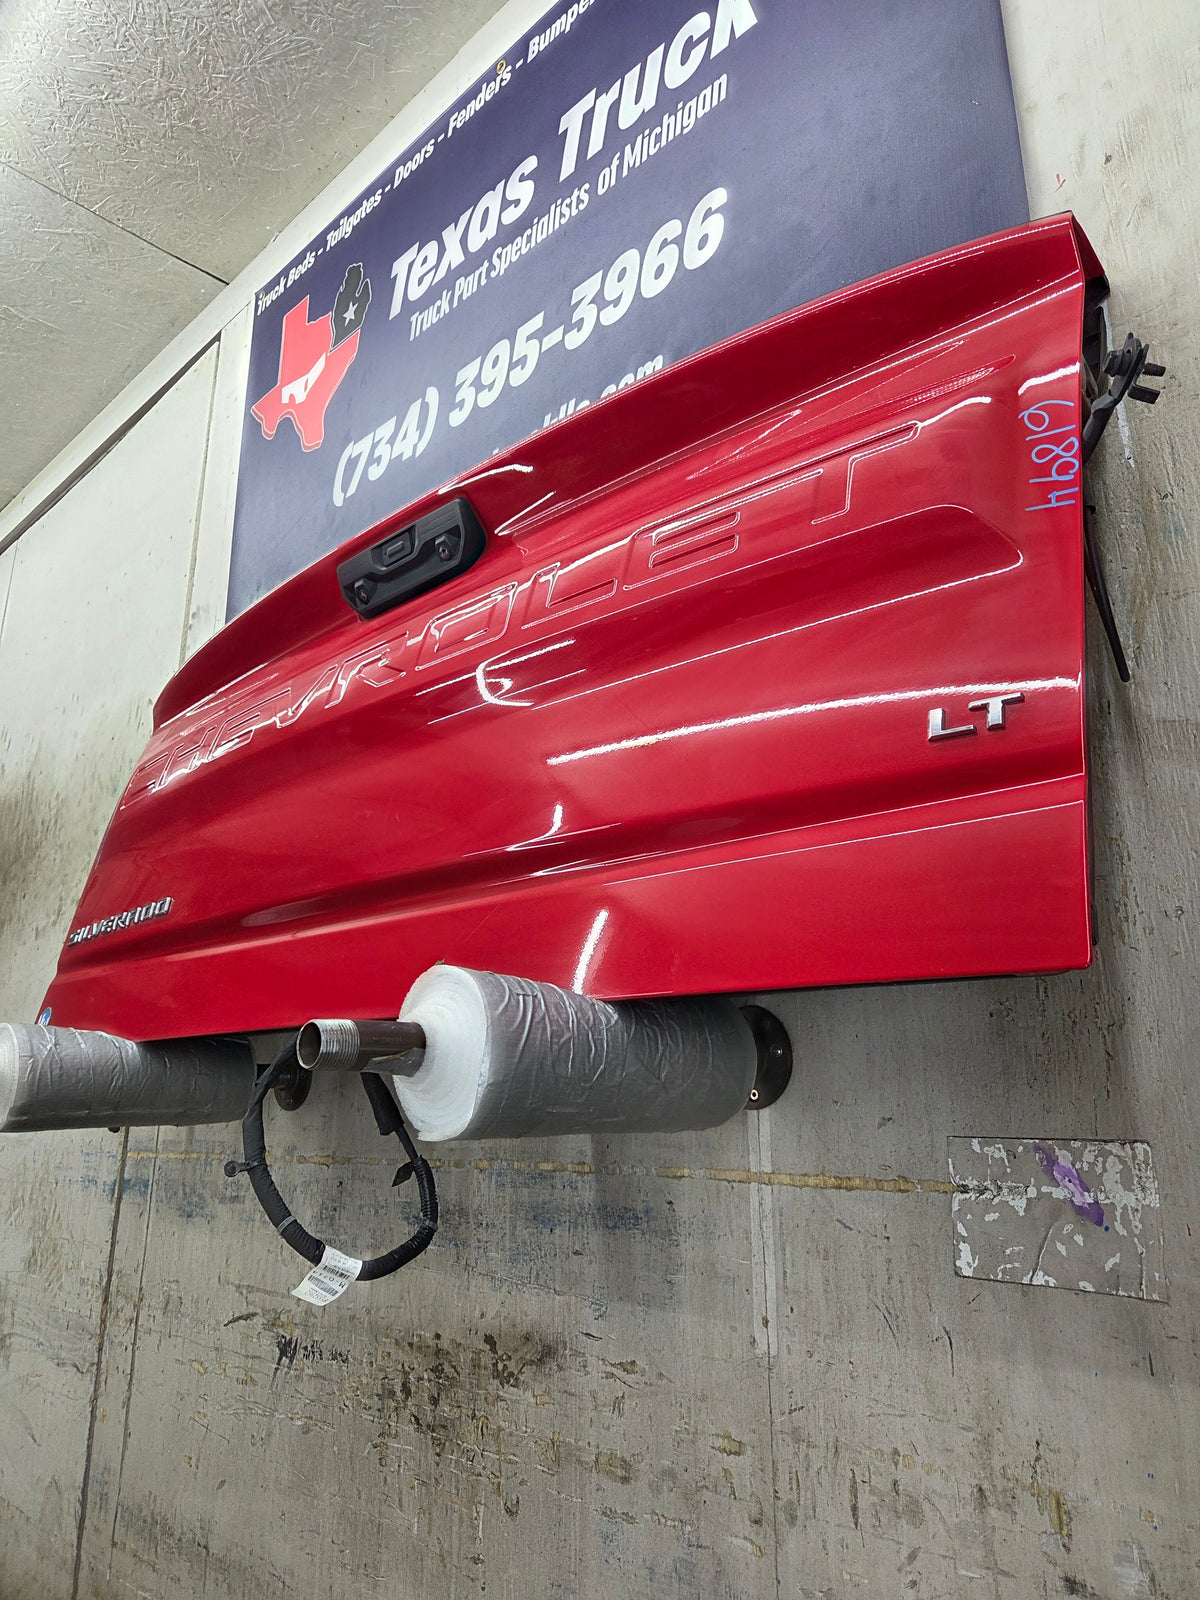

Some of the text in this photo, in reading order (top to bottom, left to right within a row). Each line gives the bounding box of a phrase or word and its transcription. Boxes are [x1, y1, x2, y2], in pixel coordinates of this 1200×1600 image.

[257, 274, 287, 315] Truck
[286, 250, 316, 288] Beds
[325, 188, 383, 252] Tailgates
[393, 138, 435, 189] Doors
[447, 64, 512, 138] Fenders
[389, 155, 538, 321] Texas
[409, 73, 728, 342] Truck Part Specialists of Michigan
[332, 386, 440, 507] (734)
[448, 186, 729, 428] 395-3966
[1017, 399, 1080, 511] 61894
[927, 691, 1025, 743] LT
[66, 896, 173, 947] SILVERADO
